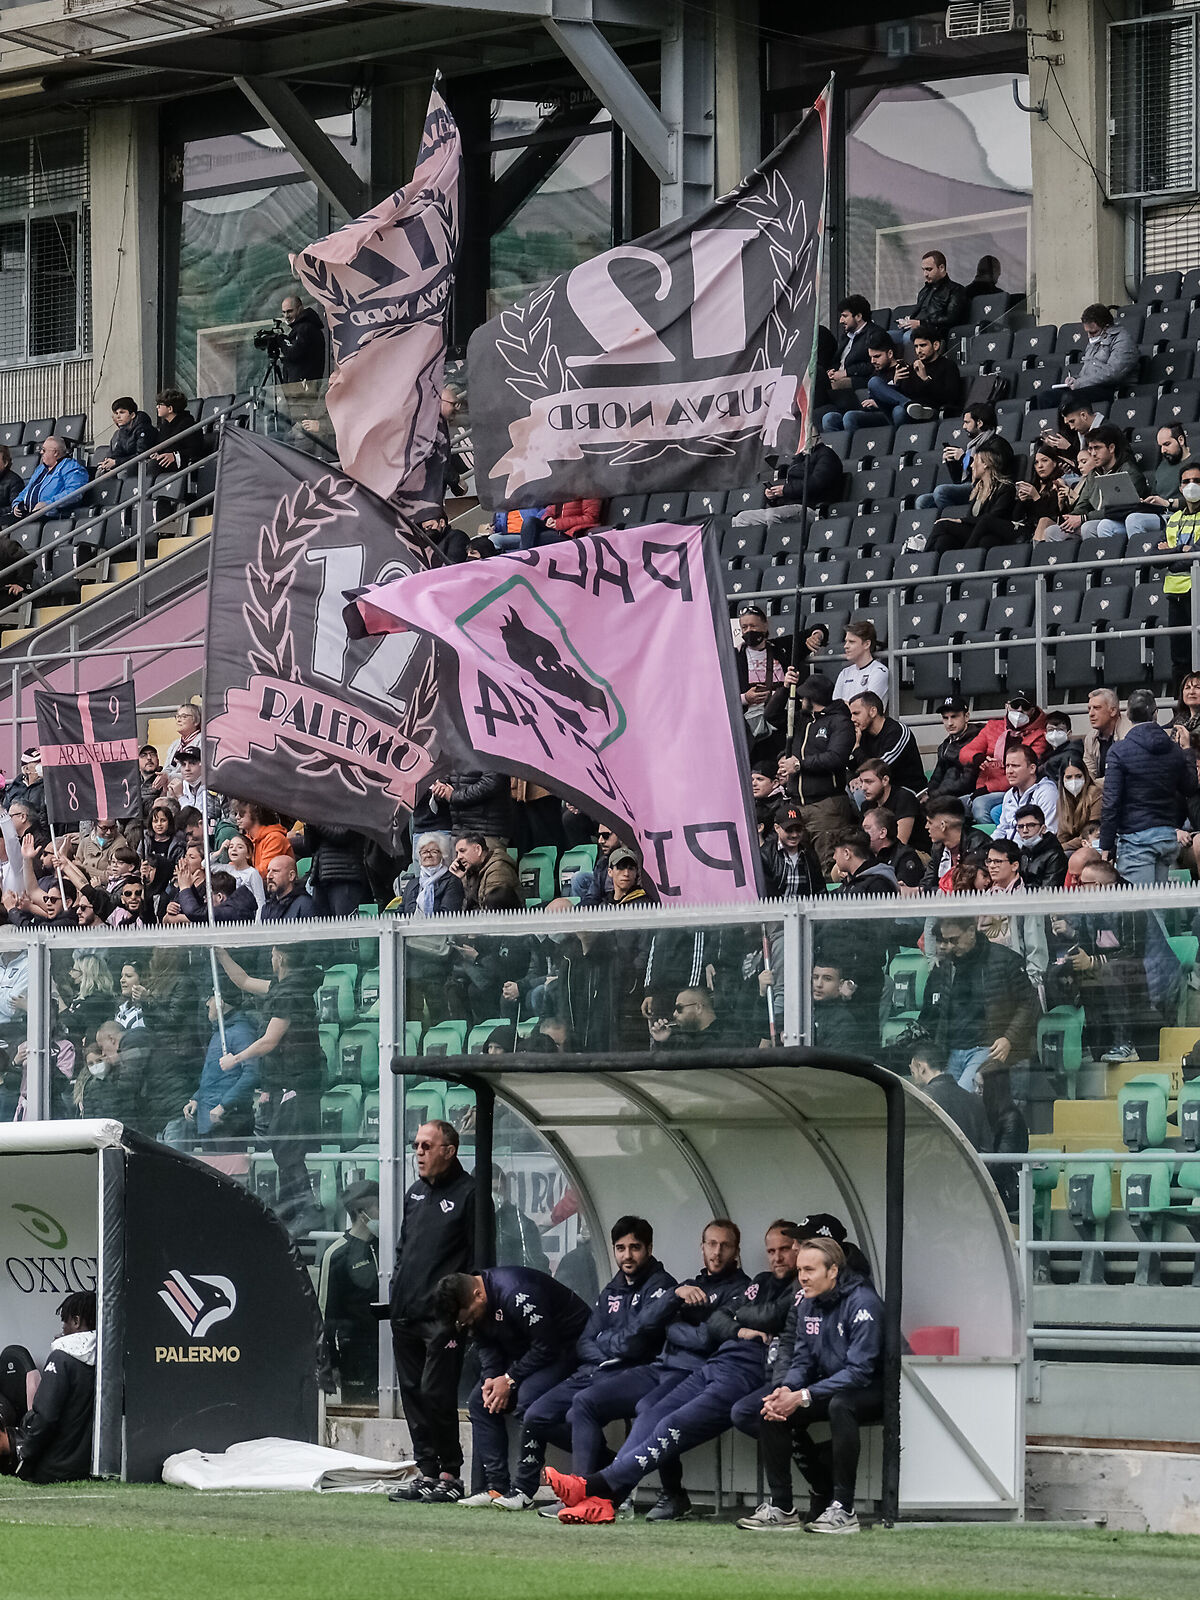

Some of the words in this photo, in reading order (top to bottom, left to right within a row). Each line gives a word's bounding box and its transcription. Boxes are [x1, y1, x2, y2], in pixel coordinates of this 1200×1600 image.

[258, 686, 421, 773] PALERMO
[58, 741, 130, 766] ARENELLA
[5, 1256, 97, 1294] OXYG
[805, 1322, 820, 1335] 96
[155, 1346, 241, 1364] PALERMO
